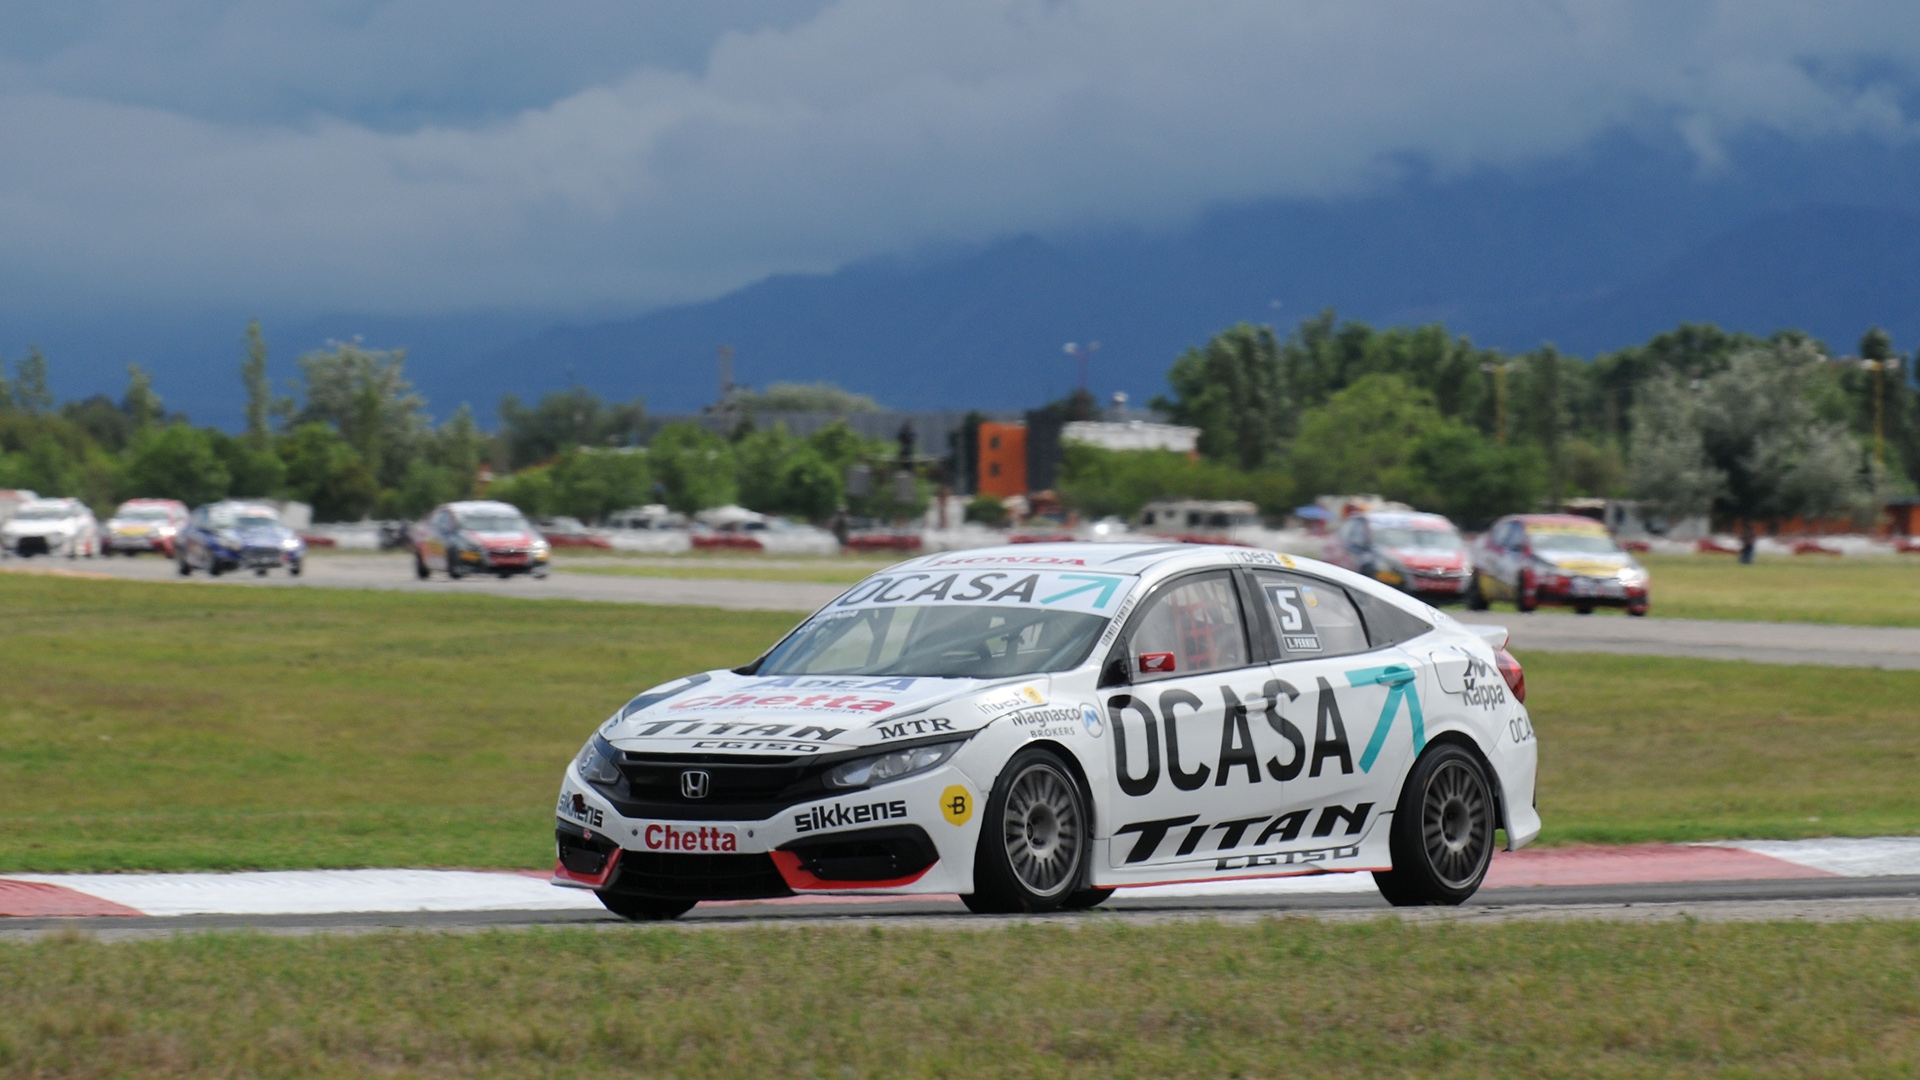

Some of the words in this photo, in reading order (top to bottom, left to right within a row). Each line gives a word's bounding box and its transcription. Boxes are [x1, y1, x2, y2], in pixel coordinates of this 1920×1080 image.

[928, 556, 1086, 568] HONDA
[836, 573, 1040, 607] OCASA
[1276, 590, 1303, 630] 5
[668, 693, 896, 712] Chetta
[1462, 678, 1506, 711] Kappa
[637, 719, 849, 741] TITAN
[877, 717, 957, 740] MTR
[1009, 708, 1080, 728] Magnasco
[1030, 726, 1076, 738] BROKERS
[1107, 676, 1354, 797] OCASA
[794, 799, 908, 833] sikkens
[644, 823, 737, 852] Chetta
[1112, 801, 1377, 864] TITAN
